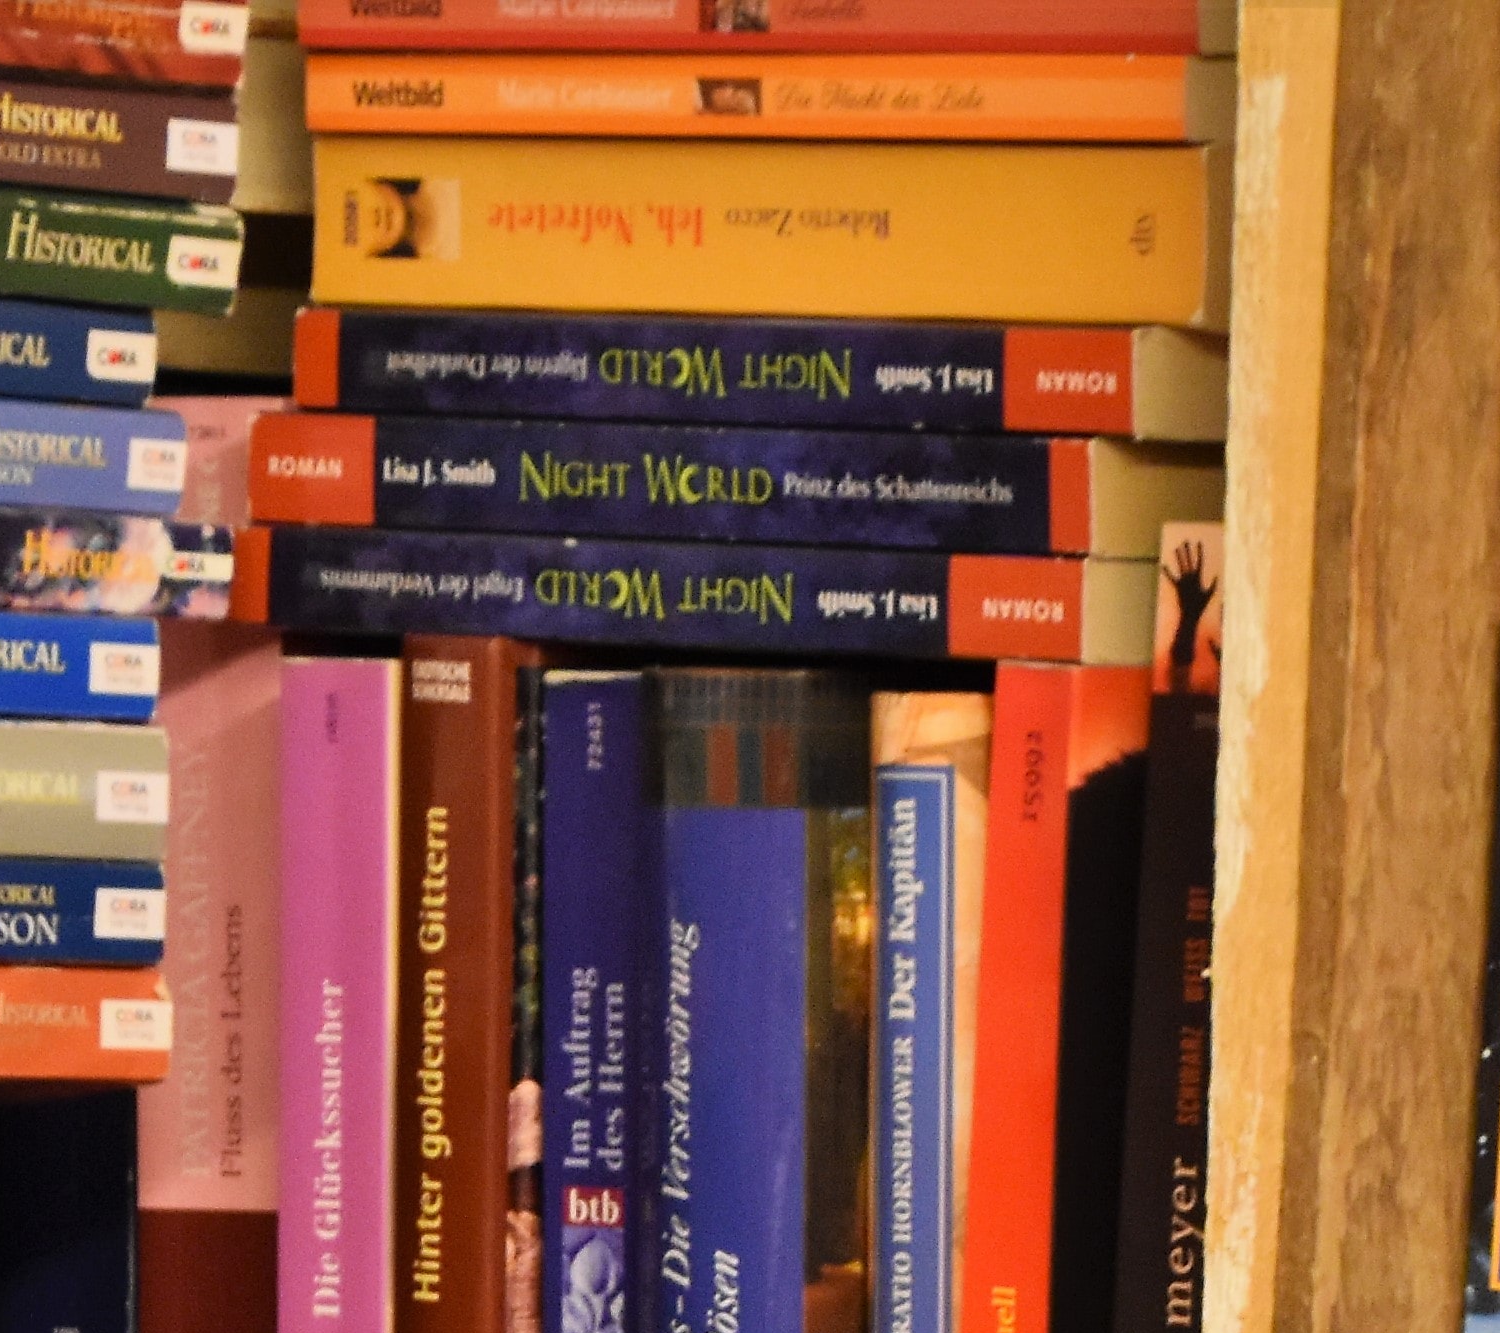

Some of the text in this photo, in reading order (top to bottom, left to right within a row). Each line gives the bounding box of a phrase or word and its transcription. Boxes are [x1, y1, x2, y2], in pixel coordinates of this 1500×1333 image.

[352, 79, 444, 110] Weltbild
[6, 210, 152, 275] HISTORICAL
[269, 455, 342, 480] ROMAN
[383, 457, 420, 485] Lisa
[442, 459, 497, 488] Smith
[519, 450, 629, 501] NIGHT
[642, 454, 772, 506] WORLD
[782, 472, 832, 499] Prinz
[837, 472, 869, 501] des
[874, 474, 1013, 508] Schattenreichs
[535, 568, 1064, 624] ROMAN NIGHT WORLD
[311, 978, 347, 1242] Glückssucher
[413, 805, 451, 1303] Hinter goldenen Gittern
[565, 968, 597, 1169] Im Auftrag
[598, 982, 624, 1172] des Herrn
[662, 918, 700, 1199] Verschwörung
[312, 1252, 340, 1318] Die
[661, 1209, 691, 1288] Die
[1164, 1157, 1203, 1326] meyer
